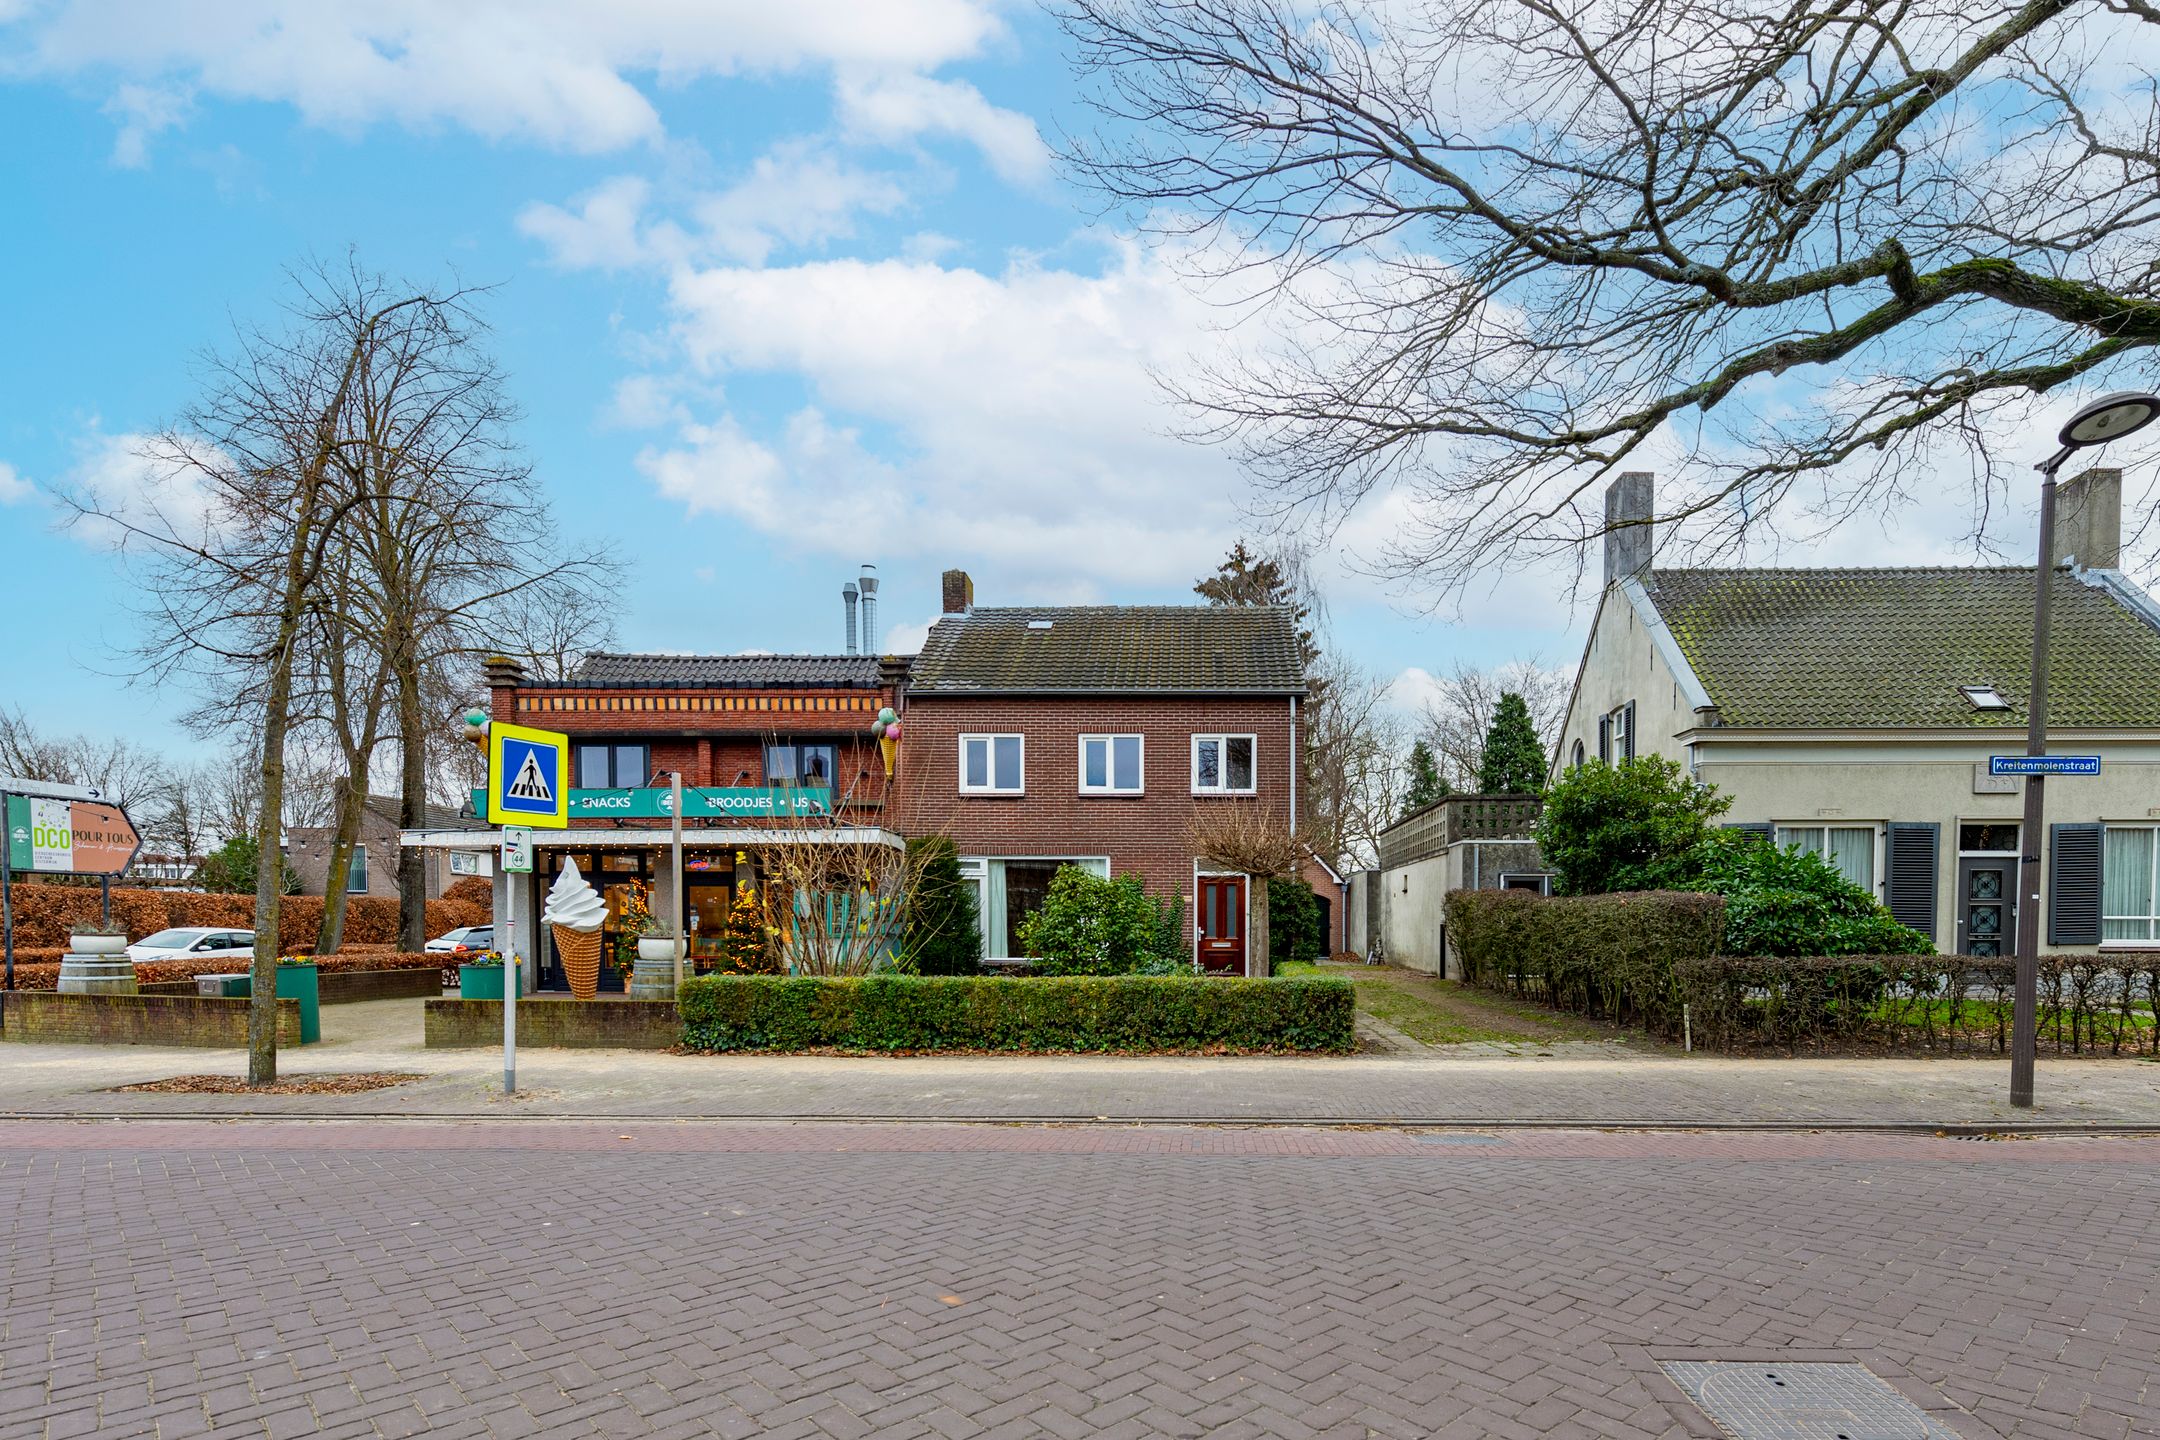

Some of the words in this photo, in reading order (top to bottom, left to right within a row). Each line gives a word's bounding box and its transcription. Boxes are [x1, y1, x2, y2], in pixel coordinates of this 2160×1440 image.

[1996, 761, 2096, 770] Kreitenmolenstraat
[582, 797, 631, 808] SNACKS
[708, 797, 773, 808] BROODJES
[792, 797, 808, 808] IJS
[33, 827, 70, 849] DCO
[72, 829, 103, 842] POUR
[106, 832, 133, 845] TOUS
